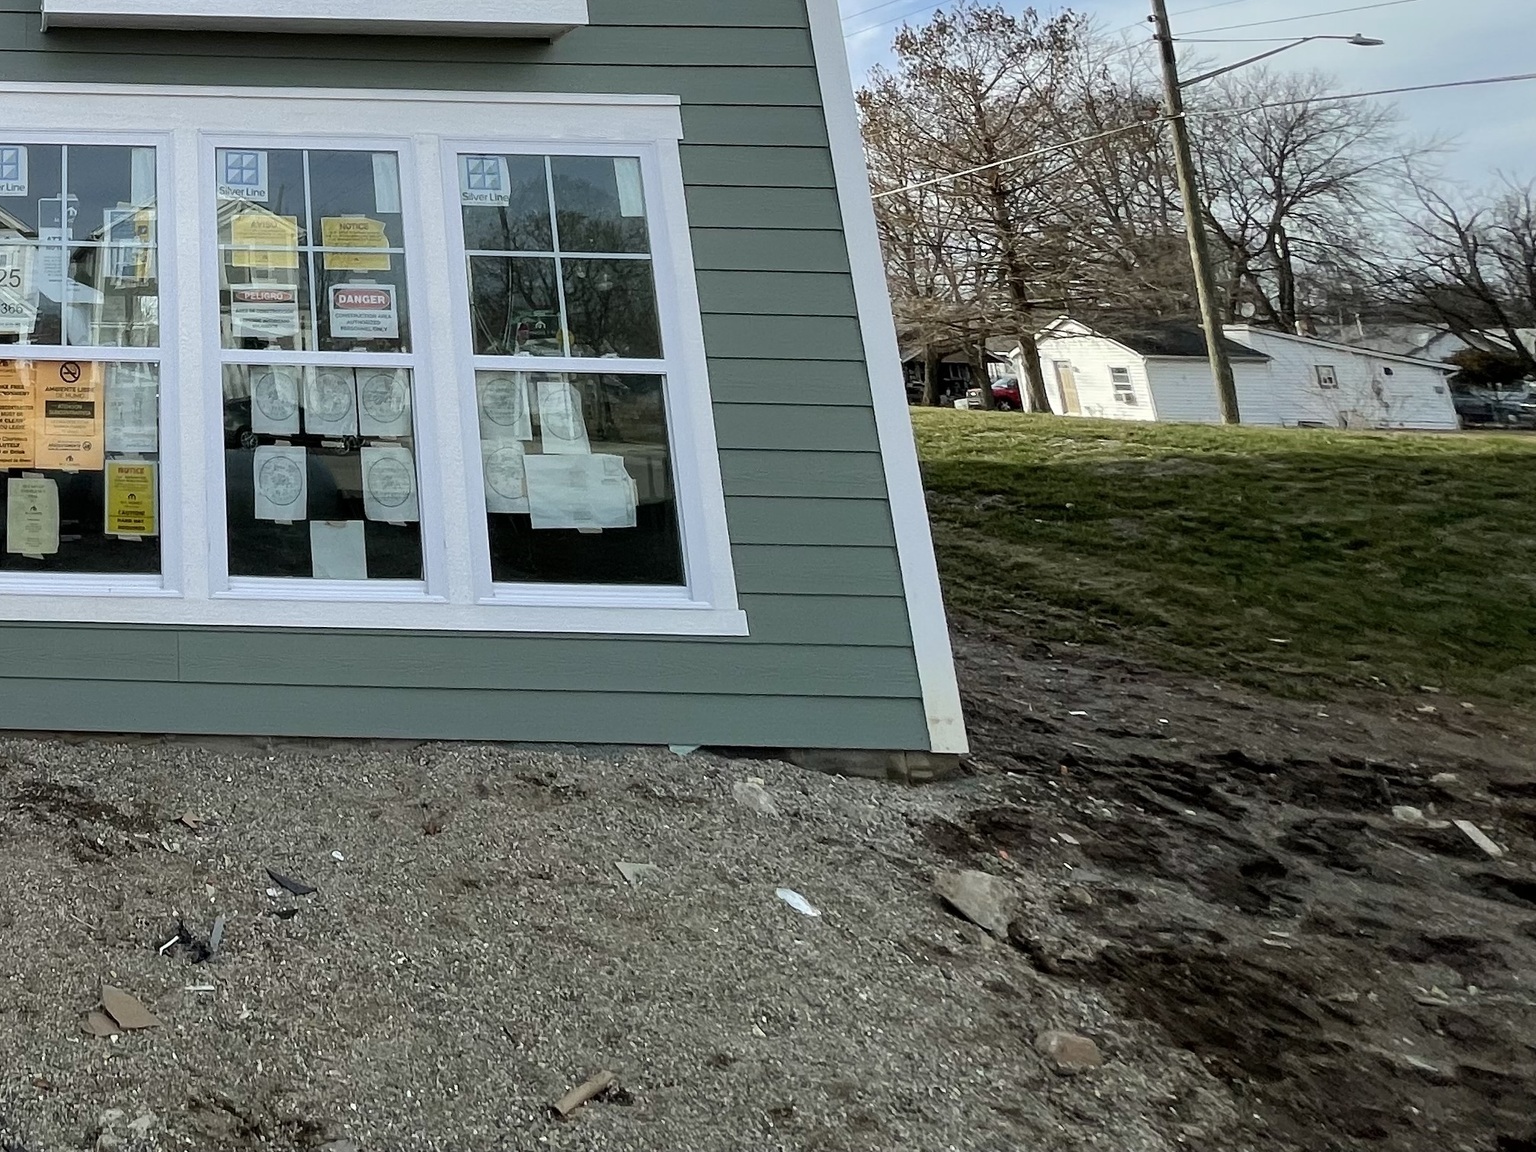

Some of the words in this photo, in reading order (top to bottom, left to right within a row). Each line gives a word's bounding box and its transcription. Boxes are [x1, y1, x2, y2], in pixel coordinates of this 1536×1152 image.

[6, 183, 25, 191] Line
[219, 186, 244, 196] Silver
[246, 188, 265, 197] Line
[462, 192, 487, 201] Silver
[489, 193, 509, 202] Line
[244, 292, 284, 300] PELIGRO
[338, 294, 385, 304] DANGER
